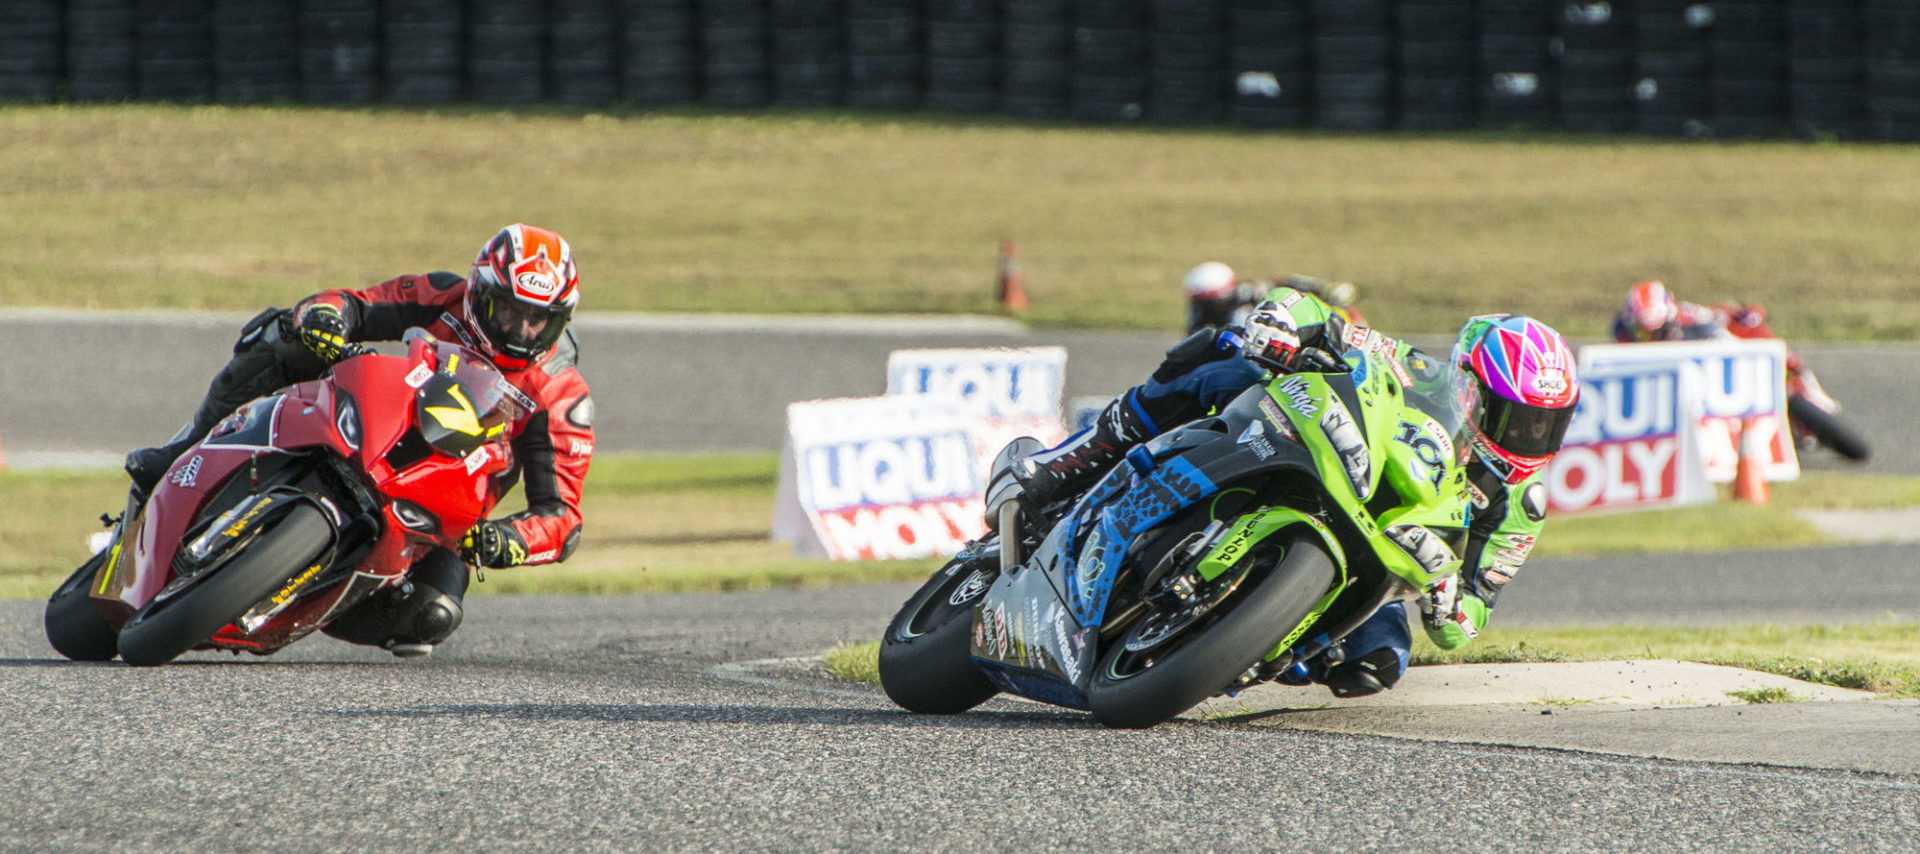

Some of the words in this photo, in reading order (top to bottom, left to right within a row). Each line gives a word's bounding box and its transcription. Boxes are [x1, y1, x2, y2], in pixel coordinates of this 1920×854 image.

[518, 273, 553, 292] Arai
[1280, 374, 1322, 419] Ninja
[1570, 373, 1674, 442] QUI
[809, 434, 973, 508] LIQUI
[1392, 420, 1448, 496] 101
[1549, 440, 1676, 511] OLY
[1054, 606, 1082, 685] Kawasaki
